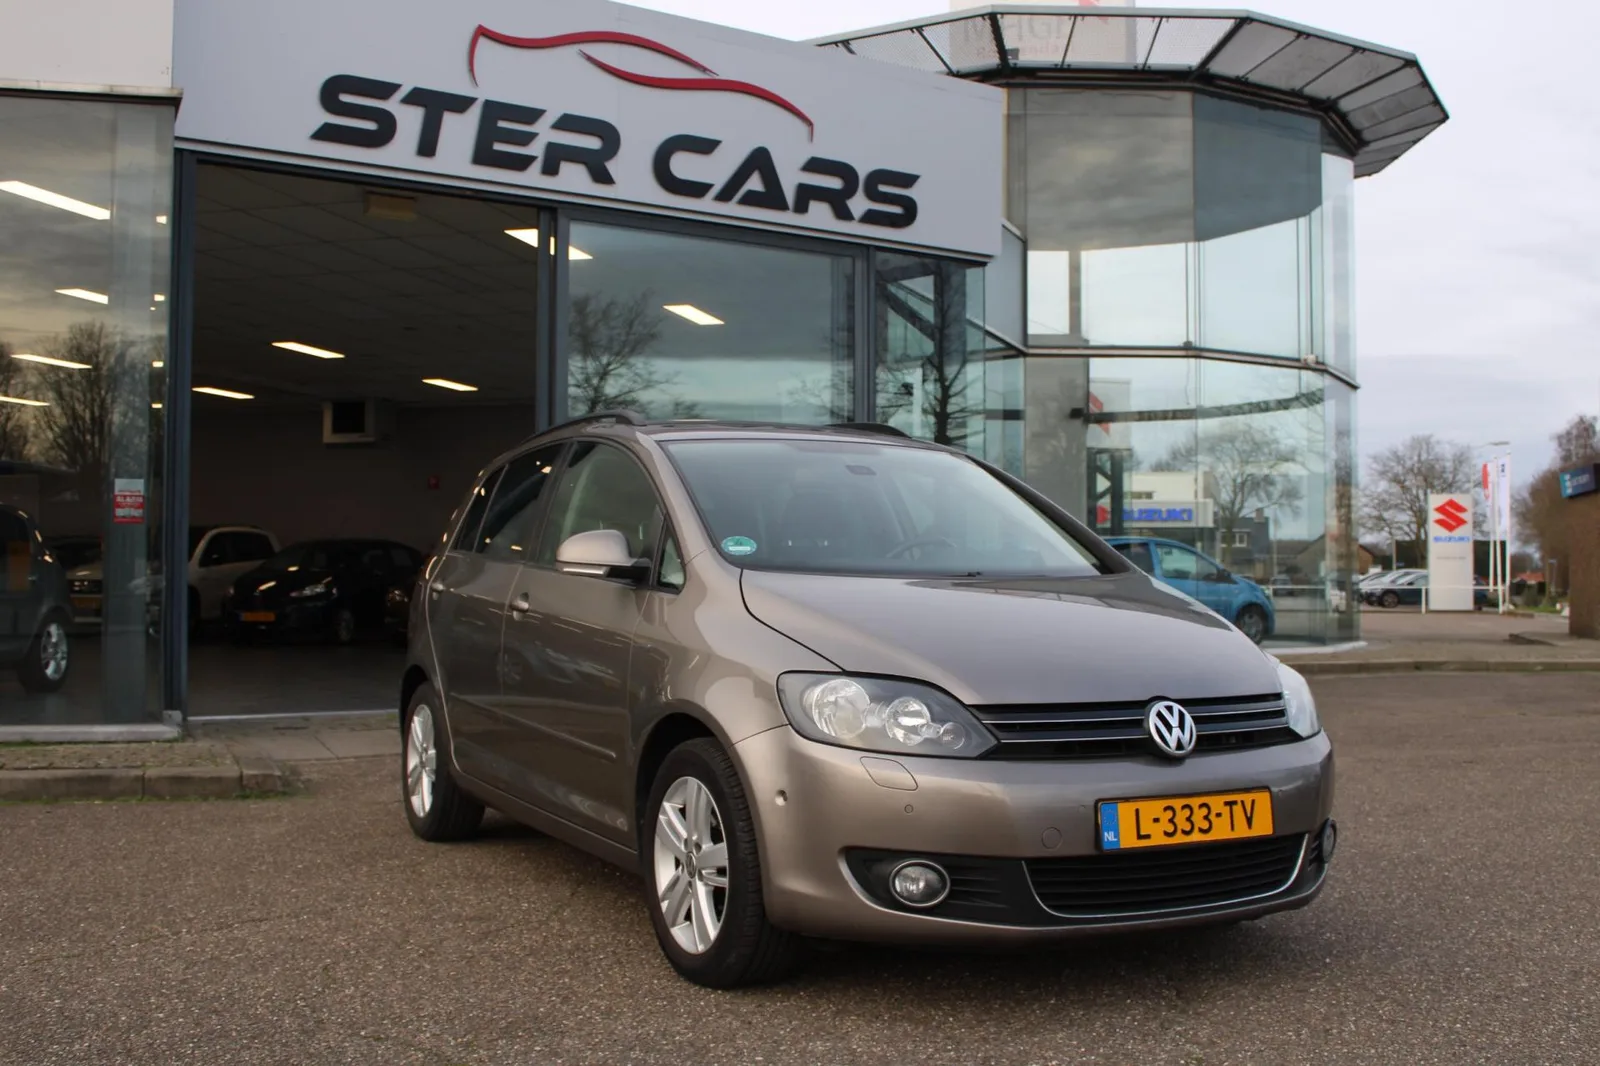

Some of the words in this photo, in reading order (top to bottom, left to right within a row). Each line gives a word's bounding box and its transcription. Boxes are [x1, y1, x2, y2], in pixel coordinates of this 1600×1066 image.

[309, 74, 620, 185] STER
[652, 134, 921, 230] CARS
[1104, 831, 1118, 841] NL
[1134, 798, 1256, 841] L-333-TV
